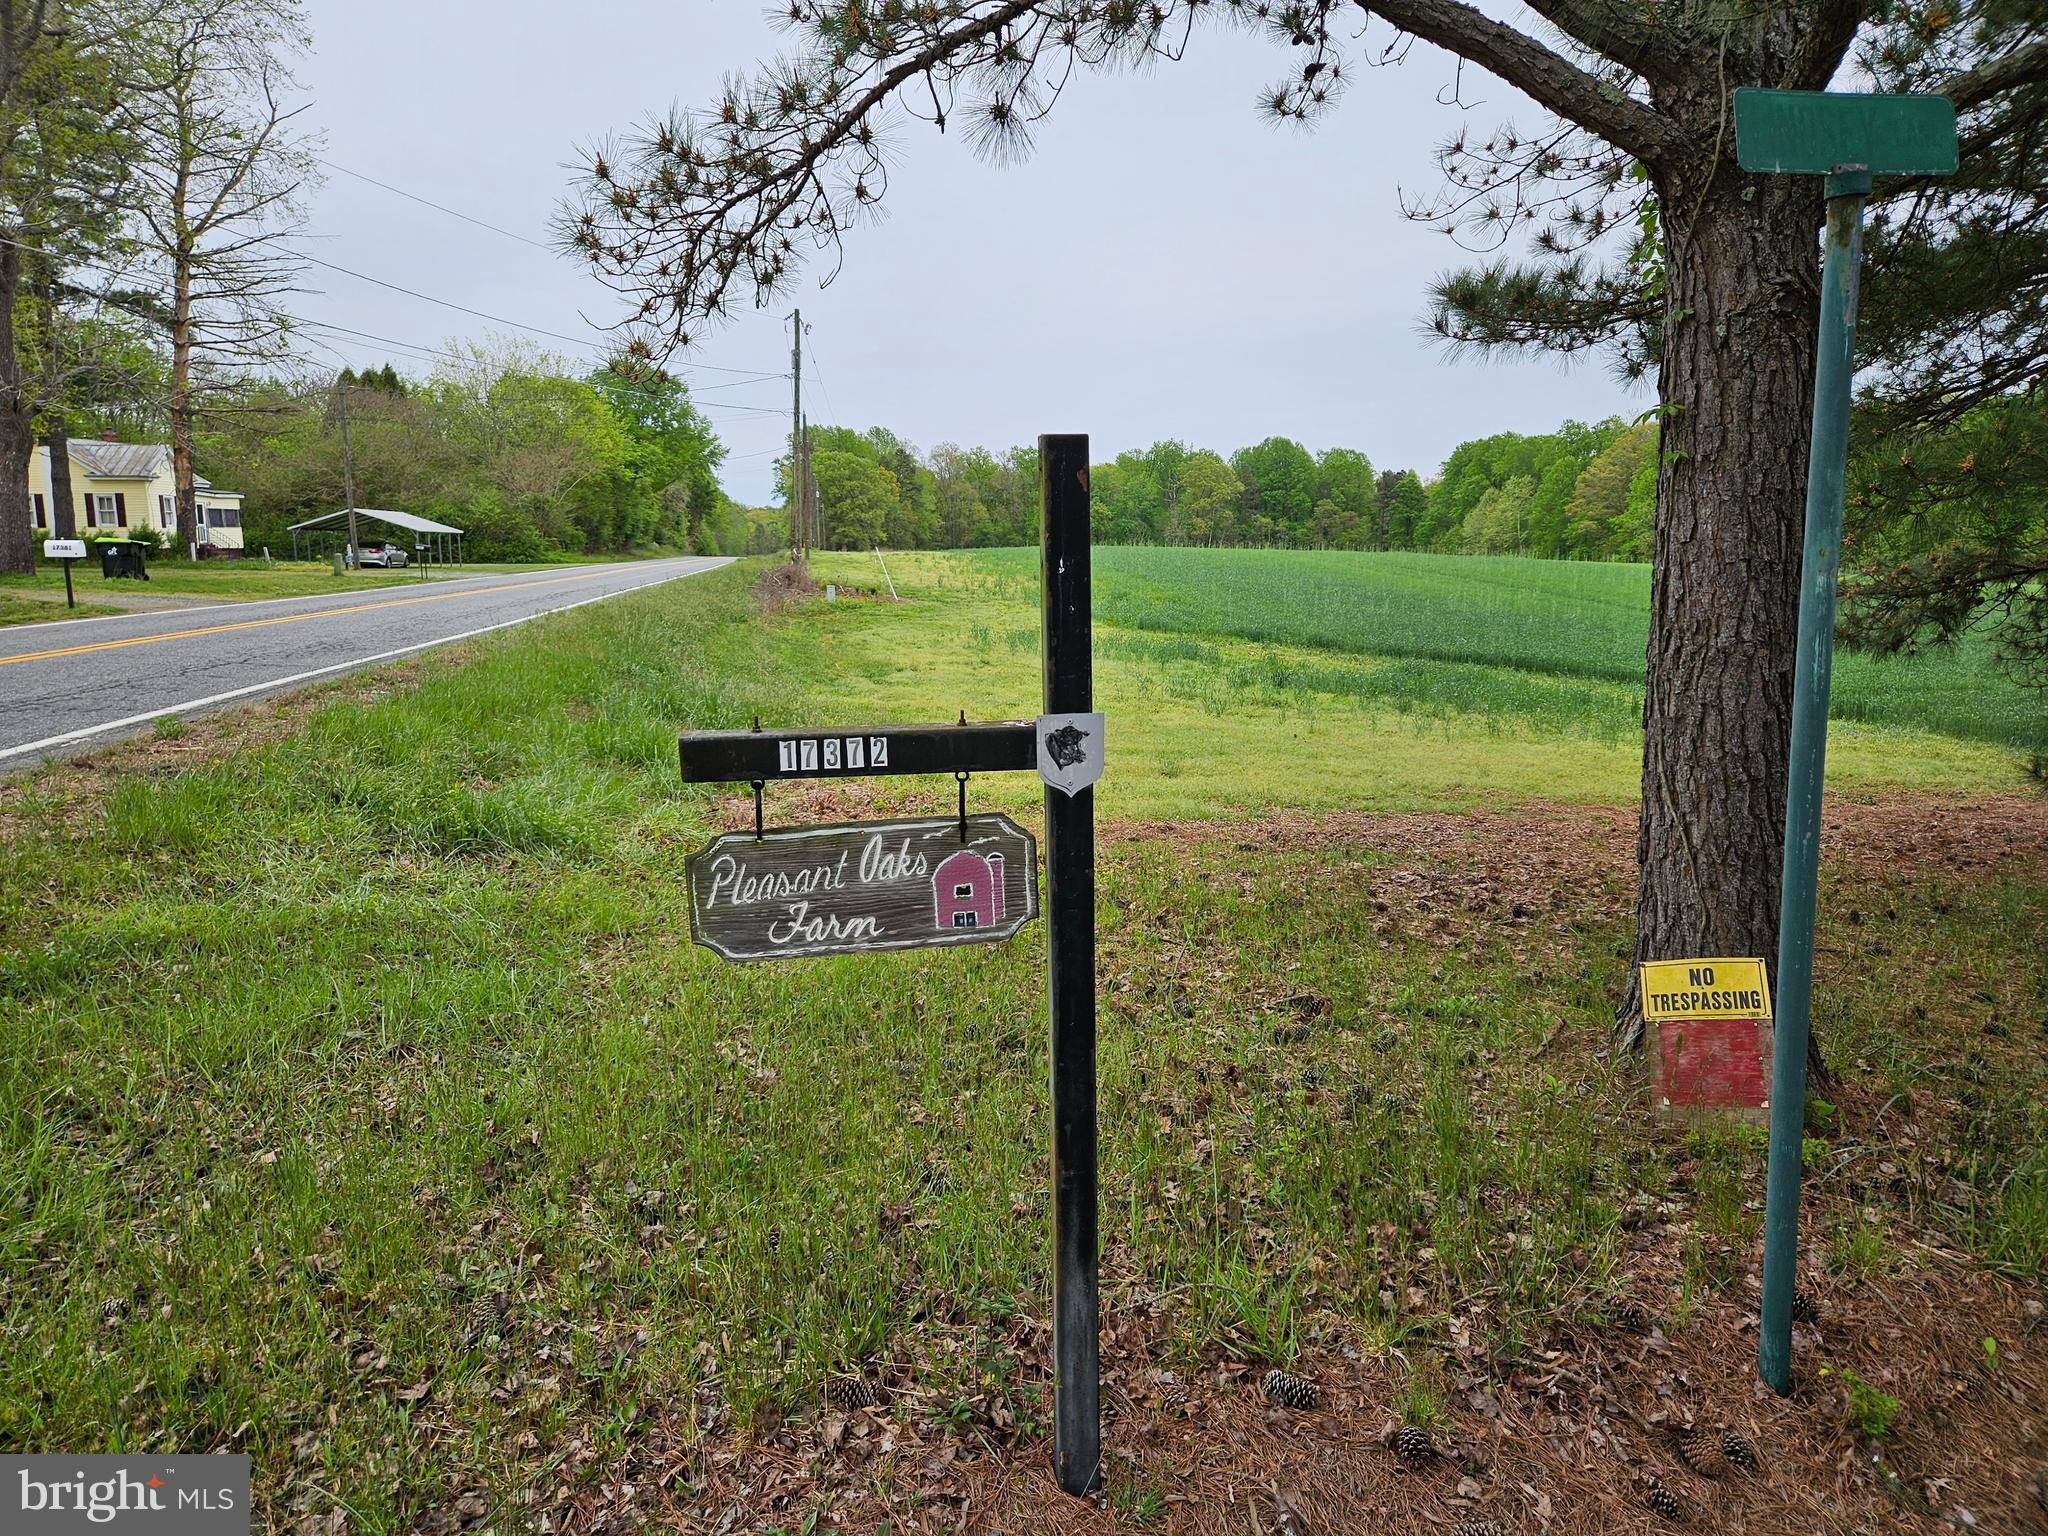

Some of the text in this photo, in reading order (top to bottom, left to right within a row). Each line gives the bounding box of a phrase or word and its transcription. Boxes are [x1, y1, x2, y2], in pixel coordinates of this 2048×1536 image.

[782, 738, 886, 769] 17372
[706, 833, 928, 909] Pleasant Oaks
[768, 900, 885, 944] Farm
[1689, 967, 1715, 987] NO
[1651, 990, 1762, 1012] TRESPASSING
